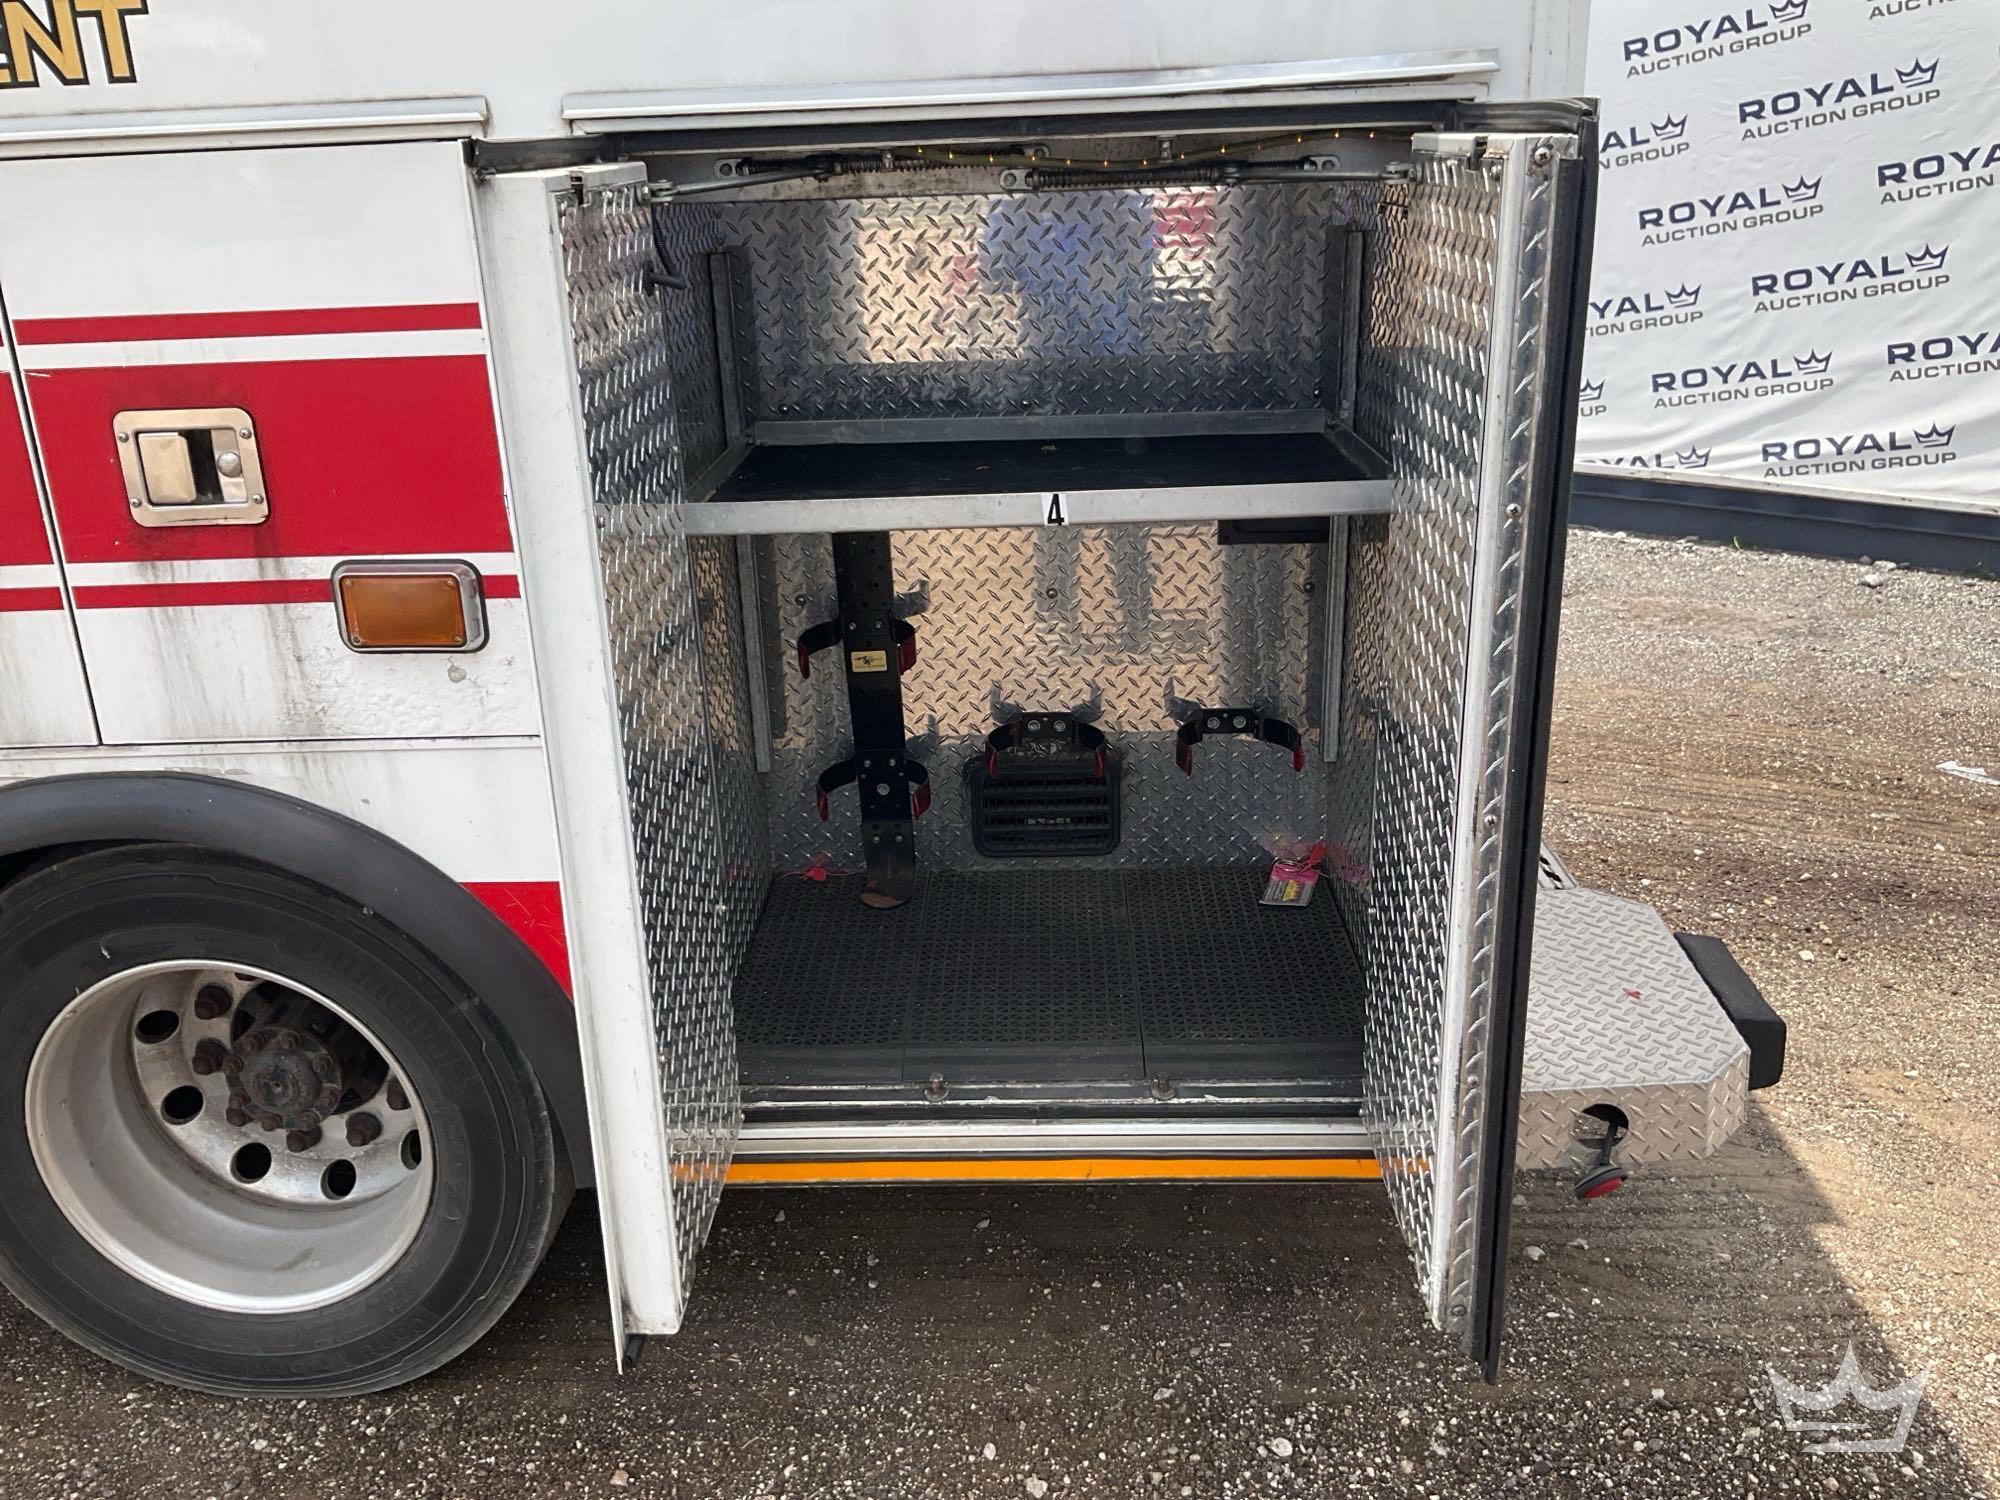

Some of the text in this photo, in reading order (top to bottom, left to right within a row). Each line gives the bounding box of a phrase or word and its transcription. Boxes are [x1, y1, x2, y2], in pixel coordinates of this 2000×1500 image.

[1624, 9, 1769, 62] ROYAL
[1627, 23, 1811, 78] AUCTION GROUP
[1739, 73, 1894, 124] ROYAL
[1742, 89, 1940, 141] AUCTION GROUP
[1615, 142, 1689, 167] GROUP
[1878, 143, 2000, 187] ROYA
[1881, 174, 1994, 205] AUCTION
[1639, 187, 1781, 230] ROYAL
[1642, 205, 1823, 246] AUCTION GROUP
[1752, 256, 1905, 297] ROYAL
[1754, 274, 1950, 313] AUCTION GROUP
[1589, 293, 1665, 320] YAL
[1630, 311, 1703, 331] GROUP
[1887, 332, 2000, 367] ROY
[1652, 359, 1792, 393] ROYAL
[1890, 358, 2000, 382] AUCTION
[1654, 378, 1833, 408] AUCTION GROUP
[1762, 431, 1912, 462] ROYAL
[1764, 452, 1957, 478] AUCTION GROUP
[1047, 493, 1065, 526] 4
